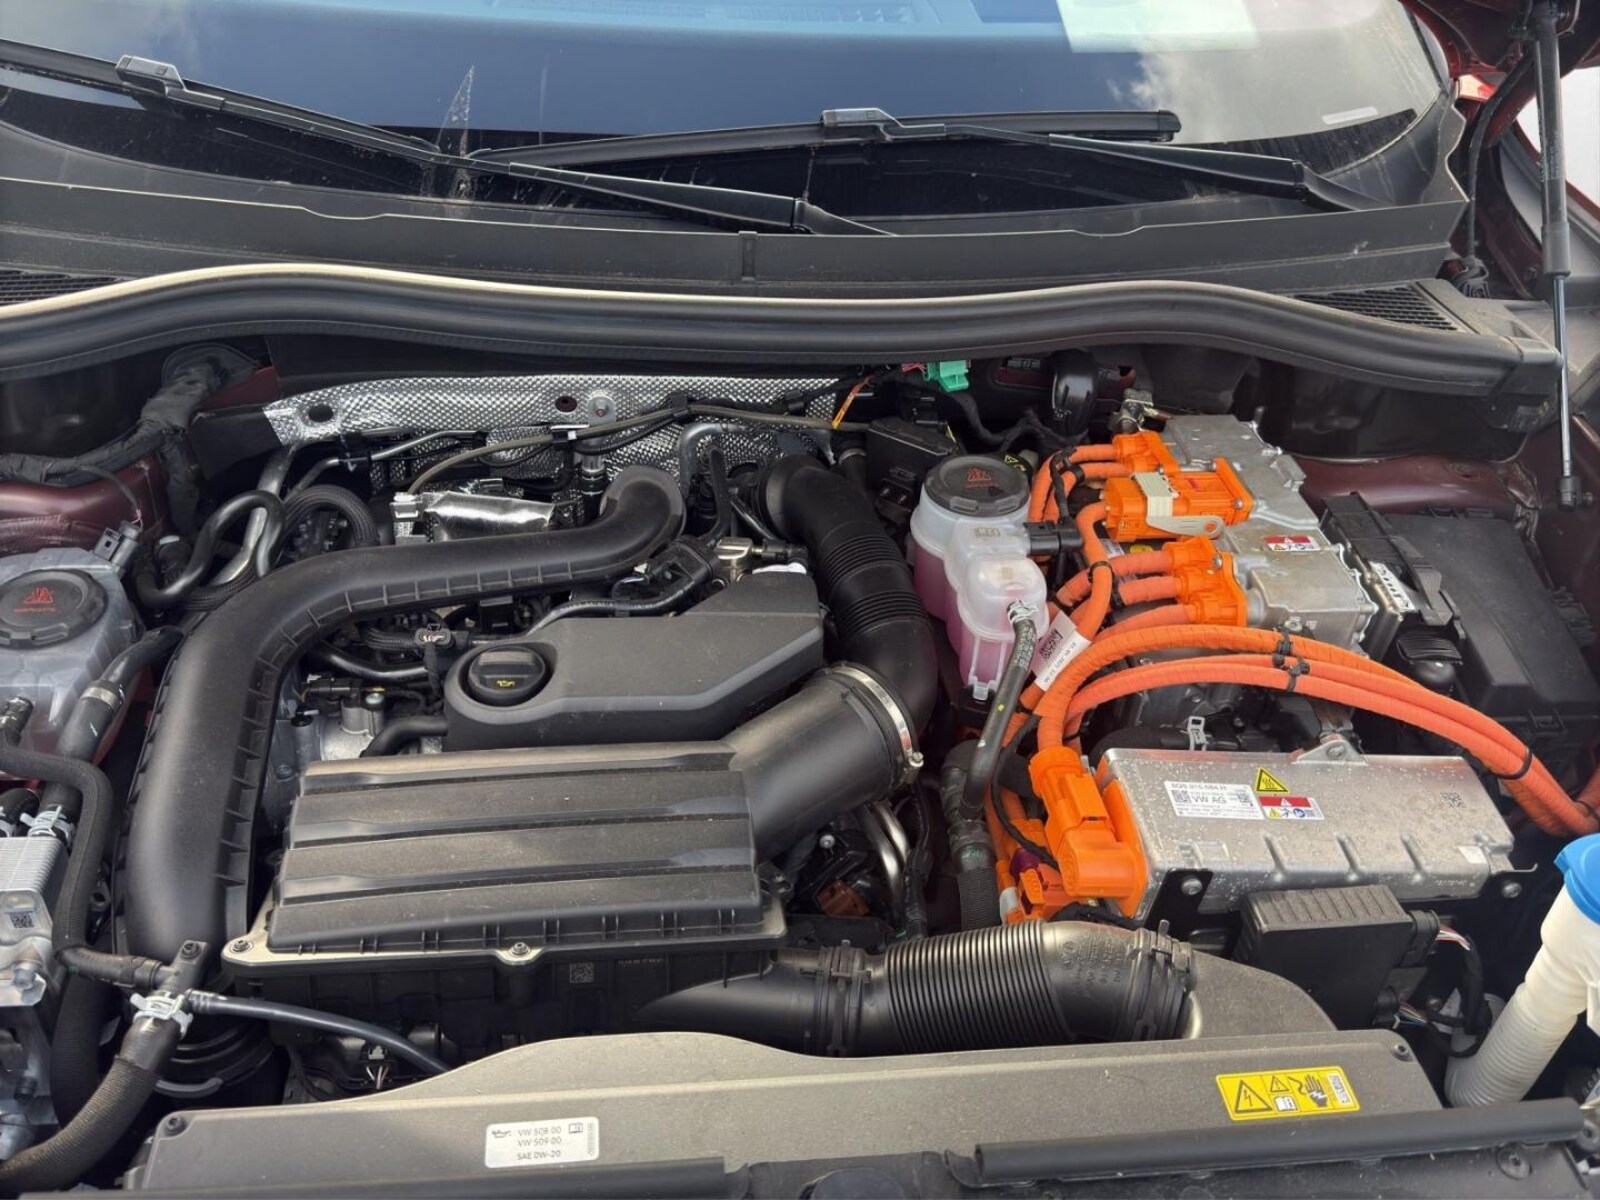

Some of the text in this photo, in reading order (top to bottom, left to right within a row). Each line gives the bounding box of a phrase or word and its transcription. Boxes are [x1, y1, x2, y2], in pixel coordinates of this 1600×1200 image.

[1212, 796, 1227, 804] AG
[518, 1126, 562, 1137] VW 508 00
[518, 1139, 532, 1147] VW
[551, 1136, 562, 1145] 00
[517, 1150, 561, 1160] SAE 0W-20
